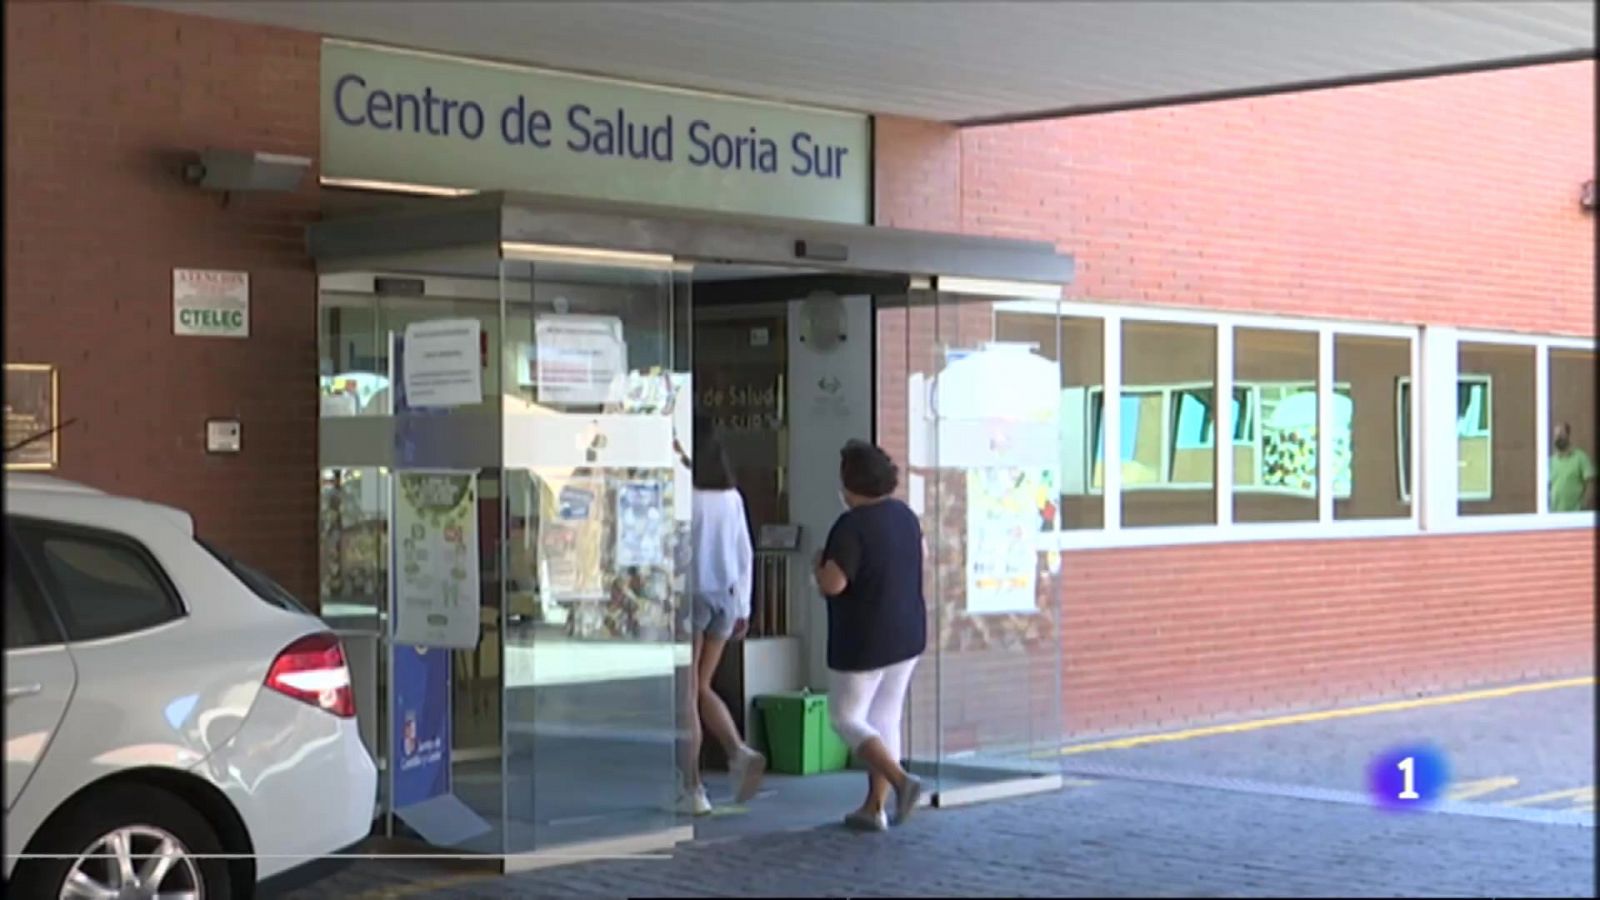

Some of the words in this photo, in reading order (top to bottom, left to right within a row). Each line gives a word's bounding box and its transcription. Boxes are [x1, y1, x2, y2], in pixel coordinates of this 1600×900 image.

[334, 74, 485, 140] Centro
[500, 95, 552, 149] de
[567, 105, 674, 163] Salud
[688, 120, 779, 174] Soria
[790, 132, 849, 181] Sur
[180, 309, 242, 327] CTELEC
